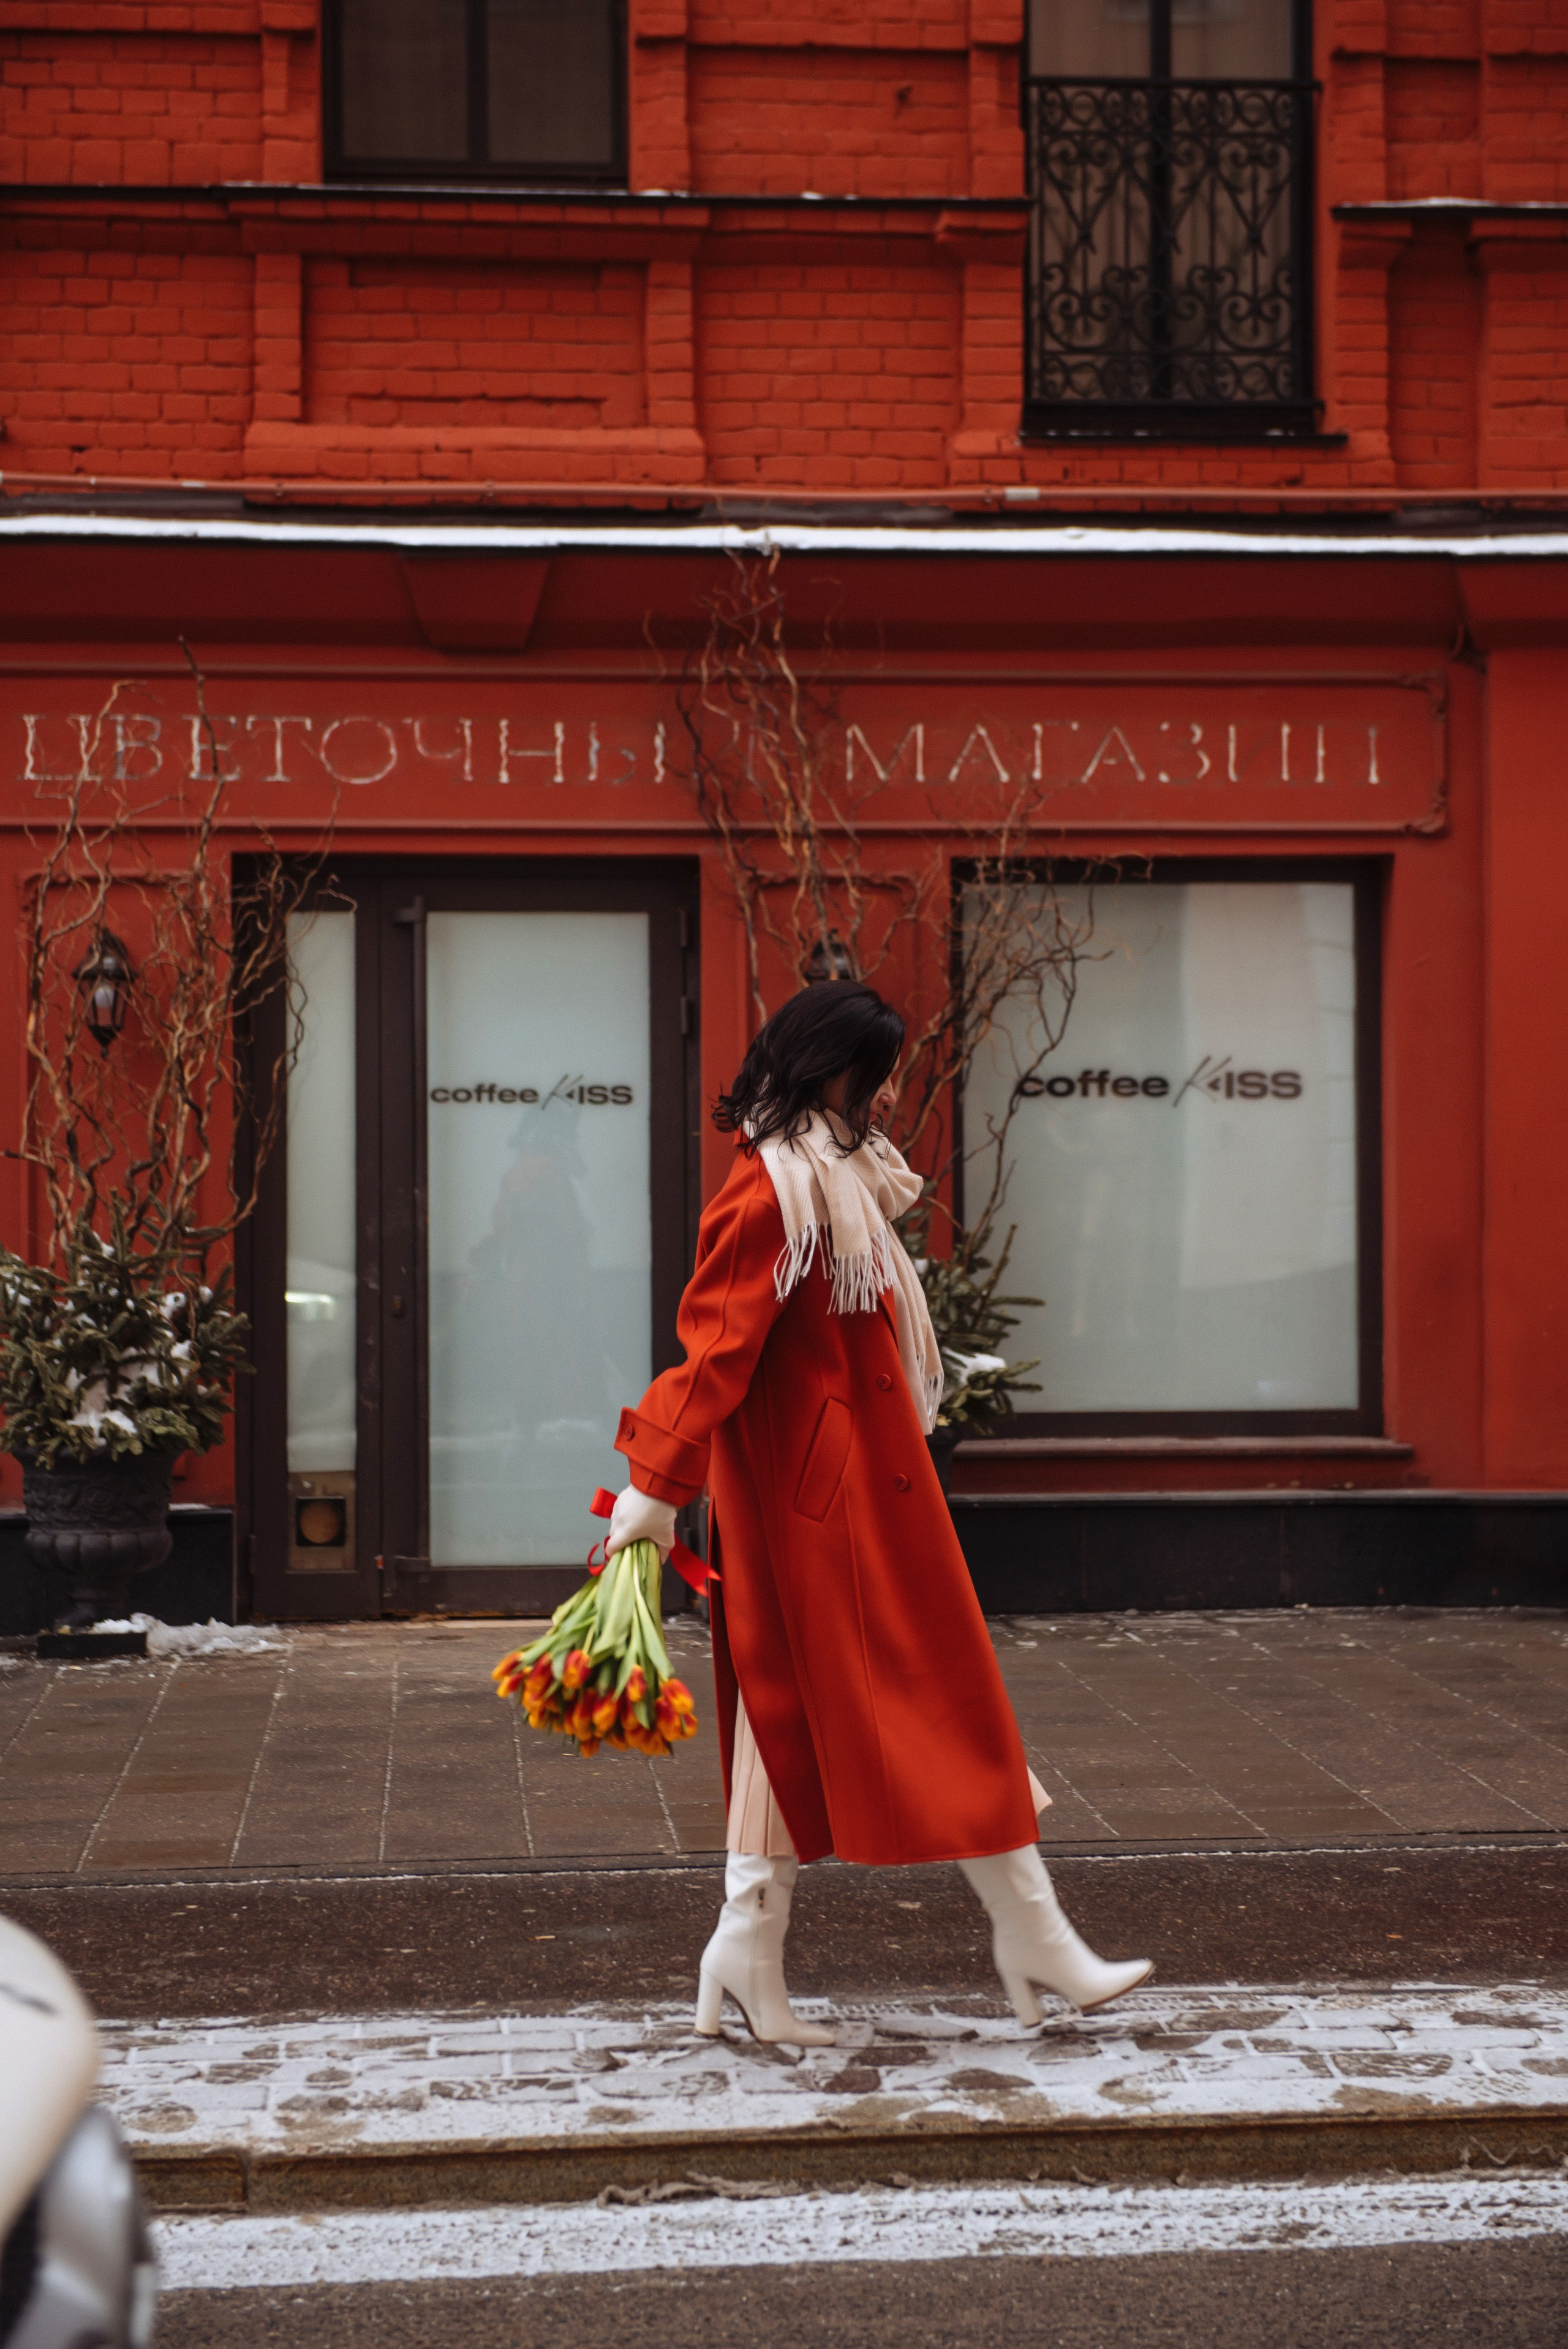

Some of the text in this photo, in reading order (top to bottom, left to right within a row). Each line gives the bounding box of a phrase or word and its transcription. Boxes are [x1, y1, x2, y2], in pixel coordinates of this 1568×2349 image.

[17, 714, 760, 786] ЦВЕТОЧНЫ
[431, 1083, 539, 1104] coffee
[1017, 1069, 1169, 1098] coffee
